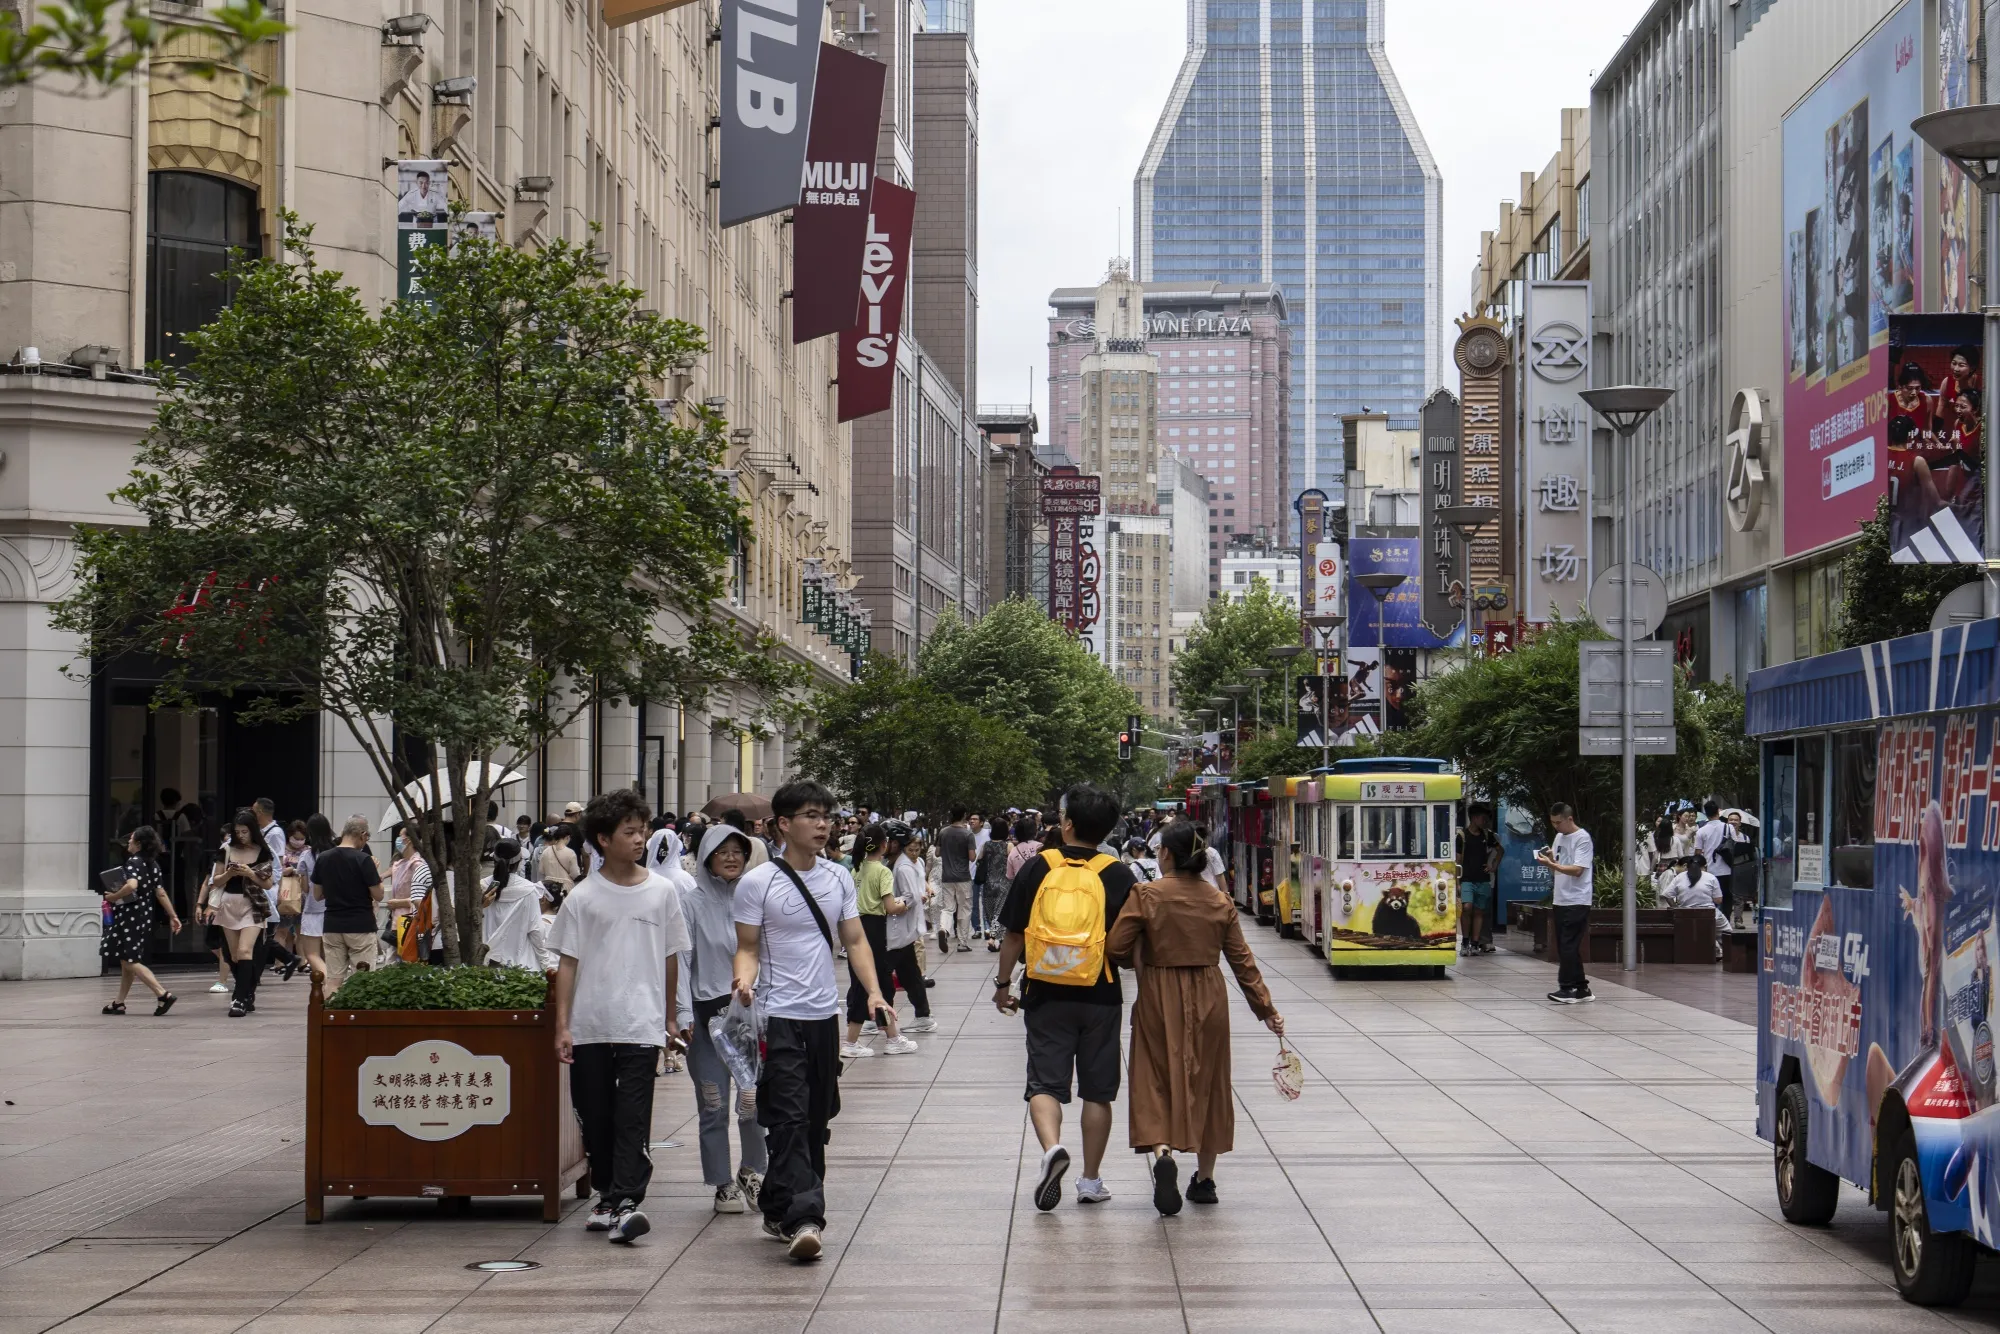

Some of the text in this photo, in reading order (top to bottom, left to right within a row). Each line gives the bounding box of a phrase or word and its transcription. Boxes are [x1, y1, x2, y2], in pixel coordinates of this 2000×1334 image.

[736, 0, 798, 135] LB
[801, 161, 868, 190] MUJI
[805, 190, 860, 206] 無印良品
[1197, 317, 1252, 332] PLAZA
[1907, 429, 1961, 439] 中国女排
[1538, 402, 1580, 582] 创趣场
[1083, 499, 1099, 512] 9F
[1382, 784, 1418, 794] 观光车
[1442, 842, 1449, 857] 8
[1373, 869, 1428, 881] 上海野生动物园
[1521, 865, 1550, 879] 智界
[372, 1071, 494, 1088] 文明旅游 共育美景
[372, 1094, 494, 1111] 诚信经营 擦亮窗口
